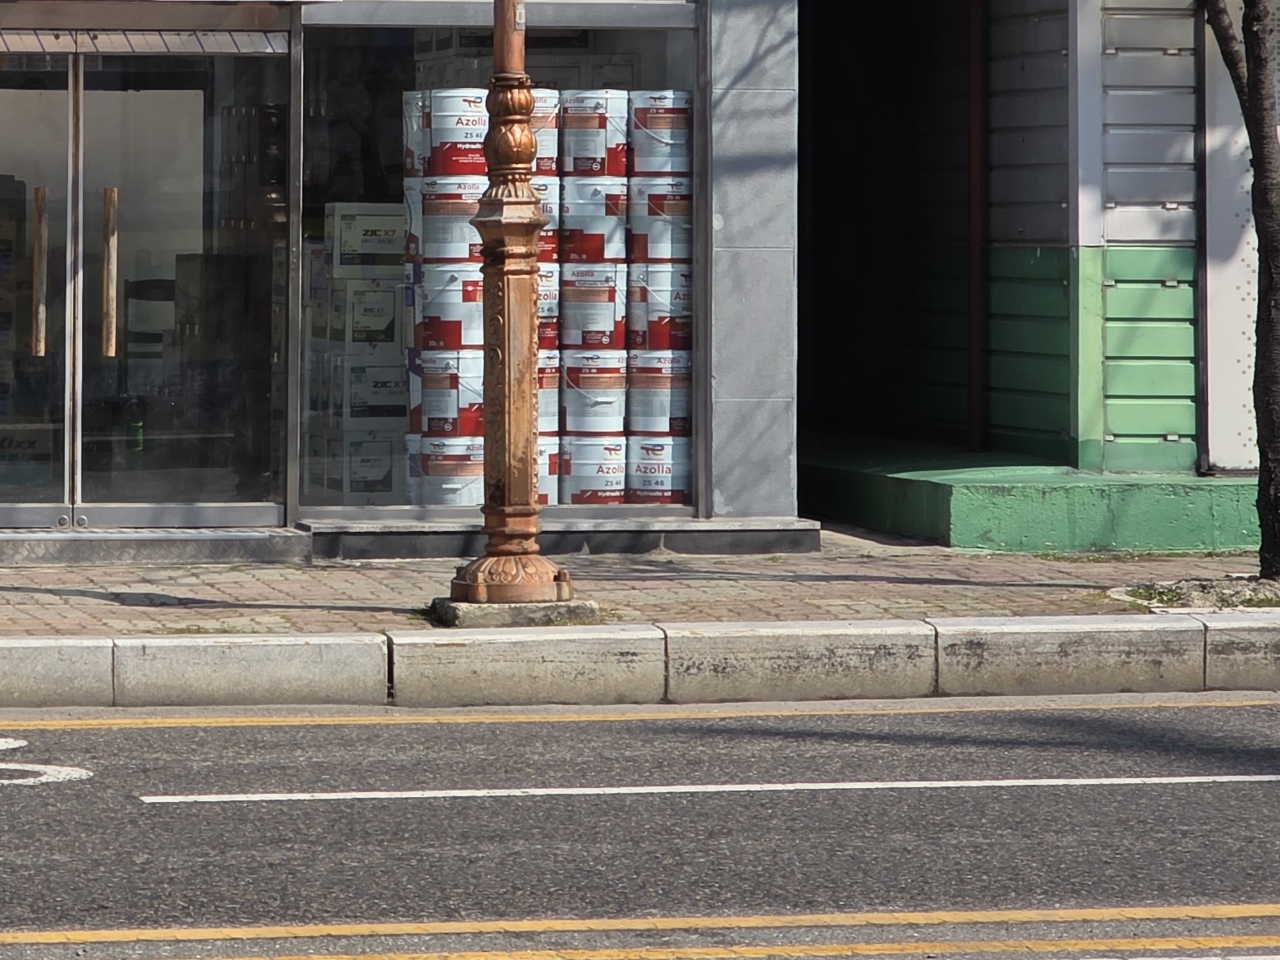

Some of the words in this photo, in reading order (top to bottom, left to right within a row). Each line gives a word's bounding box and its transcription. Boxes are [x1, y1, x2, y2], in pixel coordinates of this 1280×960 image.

[455, 117, 486, 127] Azolla
[538, 291, 557, 301] zolla
[596, 464, 624, 475] Azolla
[635, 464, 672, 474] Azolla
